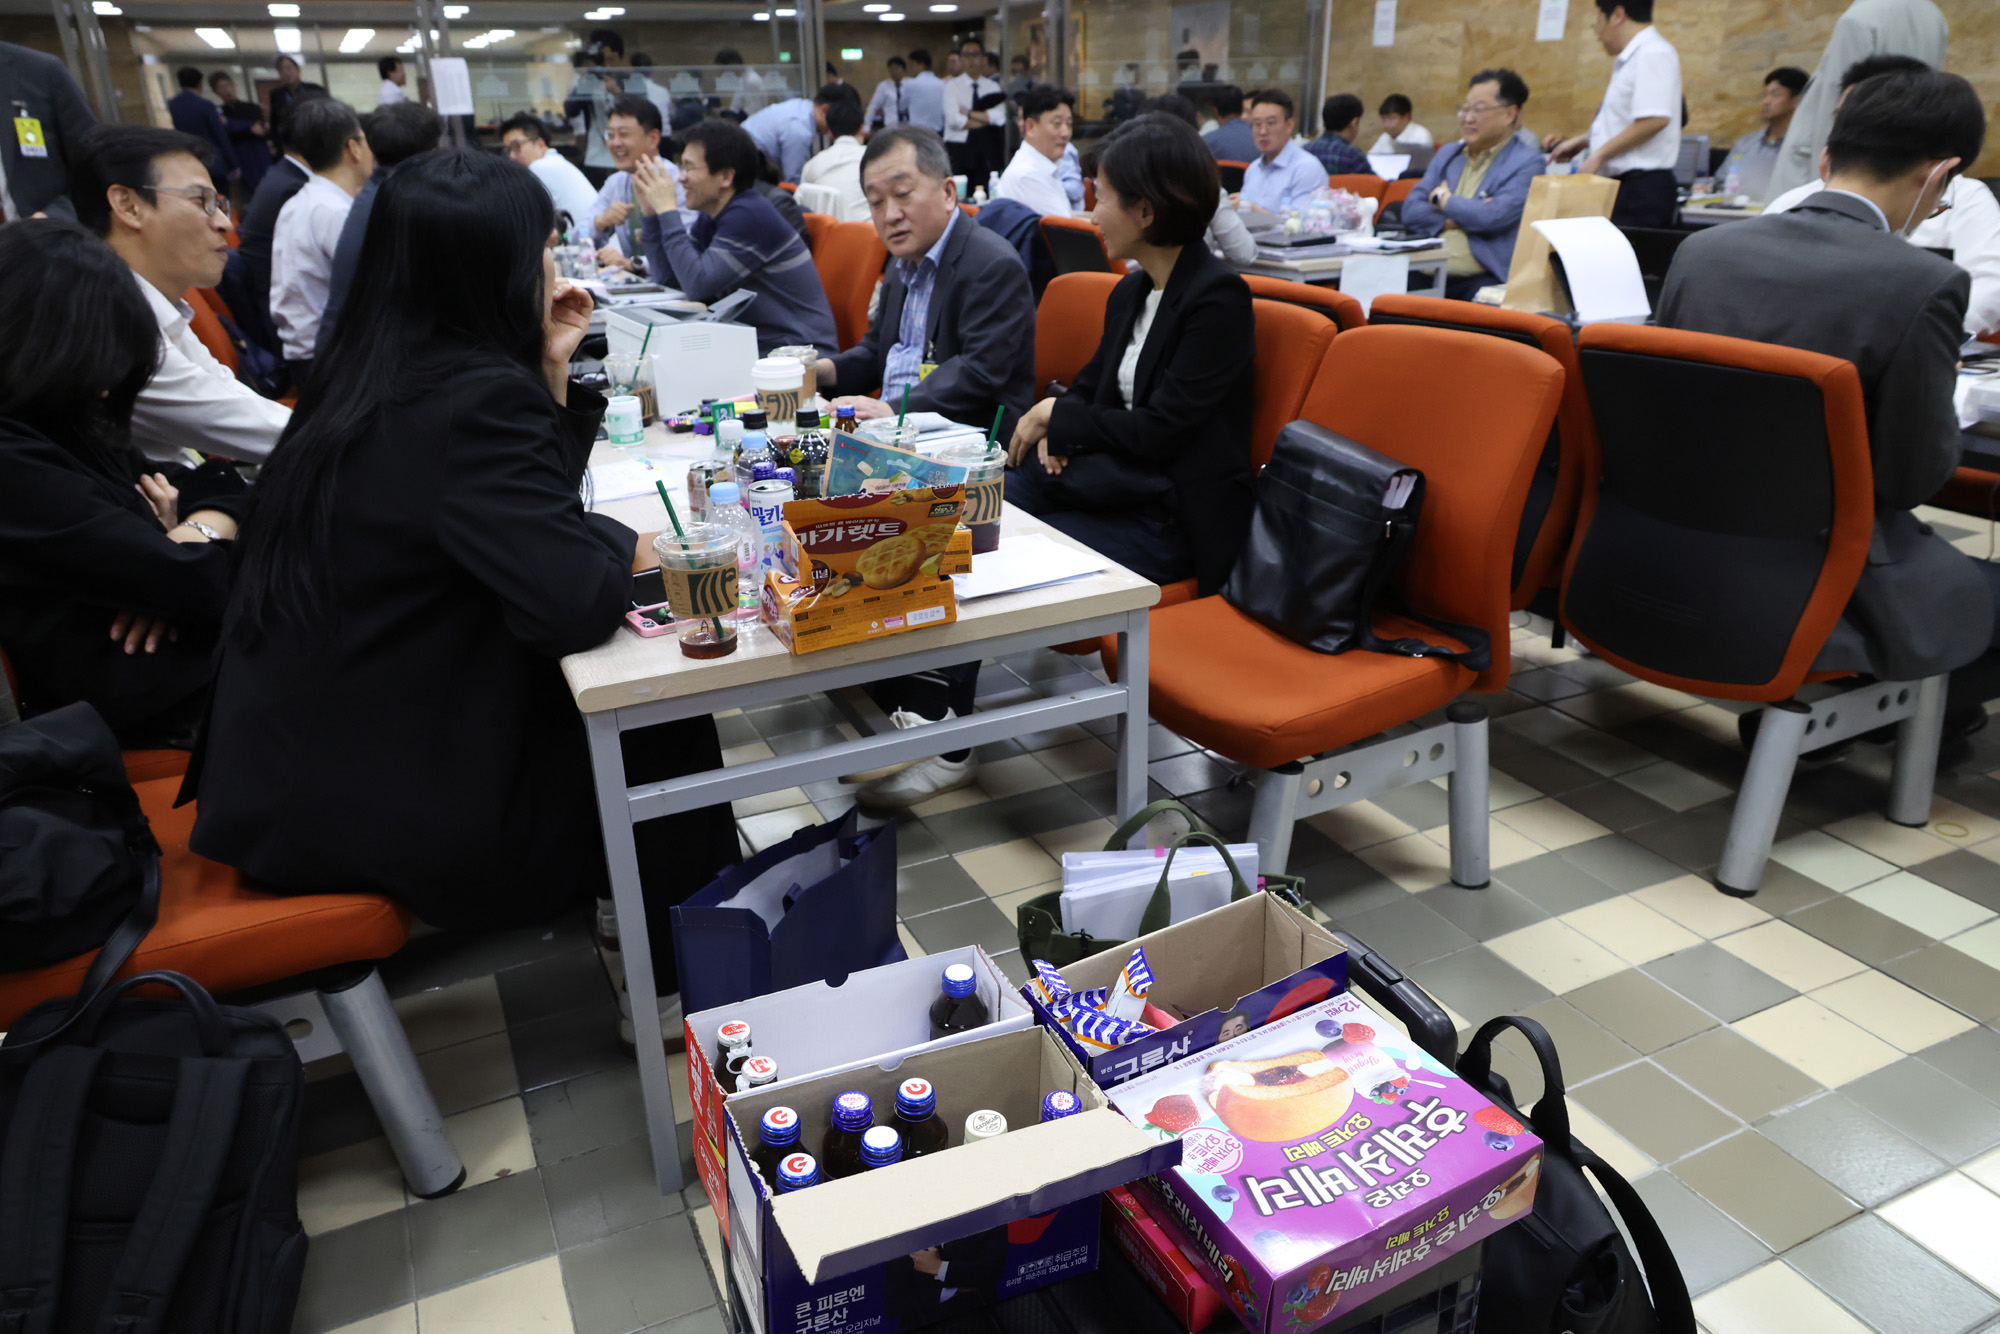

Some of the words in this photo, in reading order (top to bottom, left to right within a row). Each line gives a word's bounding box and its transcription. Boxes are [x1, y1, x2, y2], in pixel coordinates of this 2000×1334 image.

[796, 522, 902, 548] 마가렛트
[1325, 1000, 1360, 1018] 12개입
[1318, 1112, 1372, 1149] 요거트
[1212, 1138, 1240, 1160] 3가지
[1244, 1096, 1468, 1217] 후레쉬베리
[1282, 1139, 1326, 1162] 베리
[1364, 1168, 1432, 1208] 오리온
[1413, 1205, 1450, 1239] 요거트
[1435, 1184, 1507, 1247] 오리온
[1054, 1244, 1088, 1263] 취급주의
[1385, 1231, 1411, 1250] 베리
[1048, 1265, 1060, 1274] 150
[795, 1302, 812, 1320] 큰
[816, 1284, 865, 1312] 피로엔
[796, 1307, 848, 1334] 구론산
